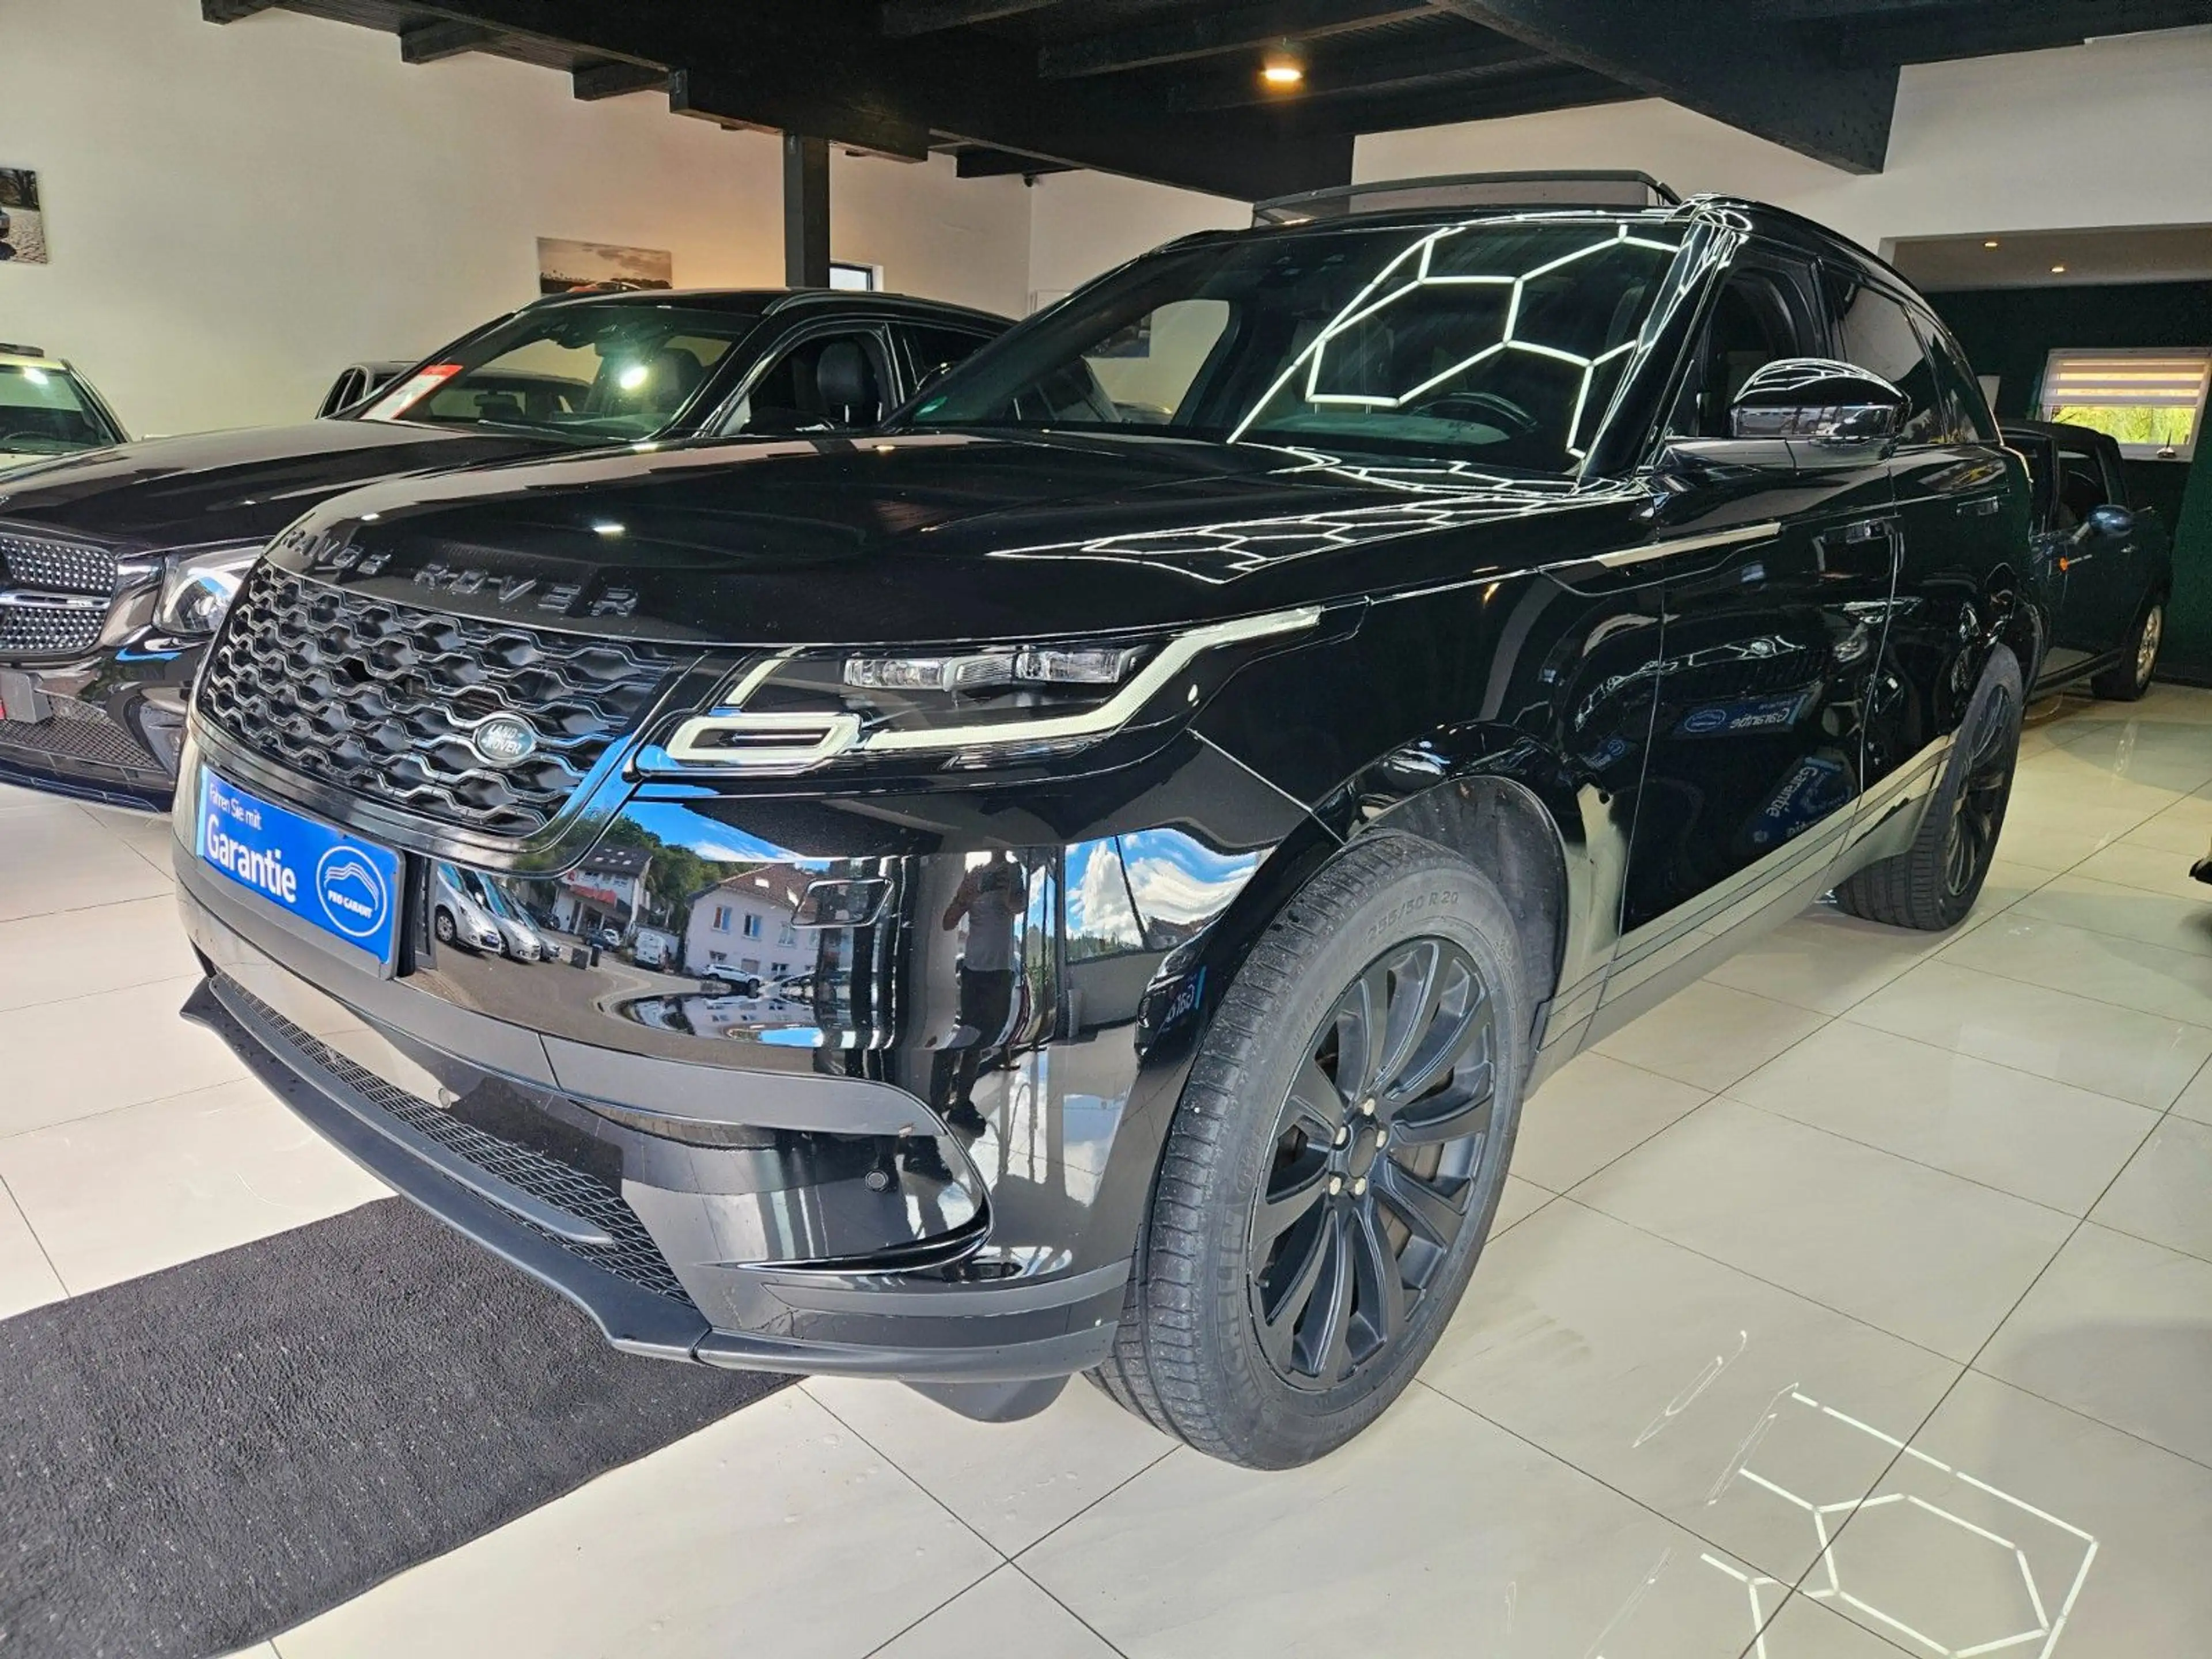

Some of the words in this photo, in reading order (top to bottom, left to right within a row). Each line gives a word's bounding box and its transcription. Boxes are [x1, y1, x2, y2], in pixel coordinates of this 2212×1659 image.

[281, 529, 393, 574] RANGE
[412, 559, 638, 617] ROVER
[230, 797, 245, 822] Sie
[244, 808, 263, 831] mit
[206, 813, 297, 904] Garantie
[1428, 891, 1438, 906] R
[1441, 890, 1460, 905] 20
